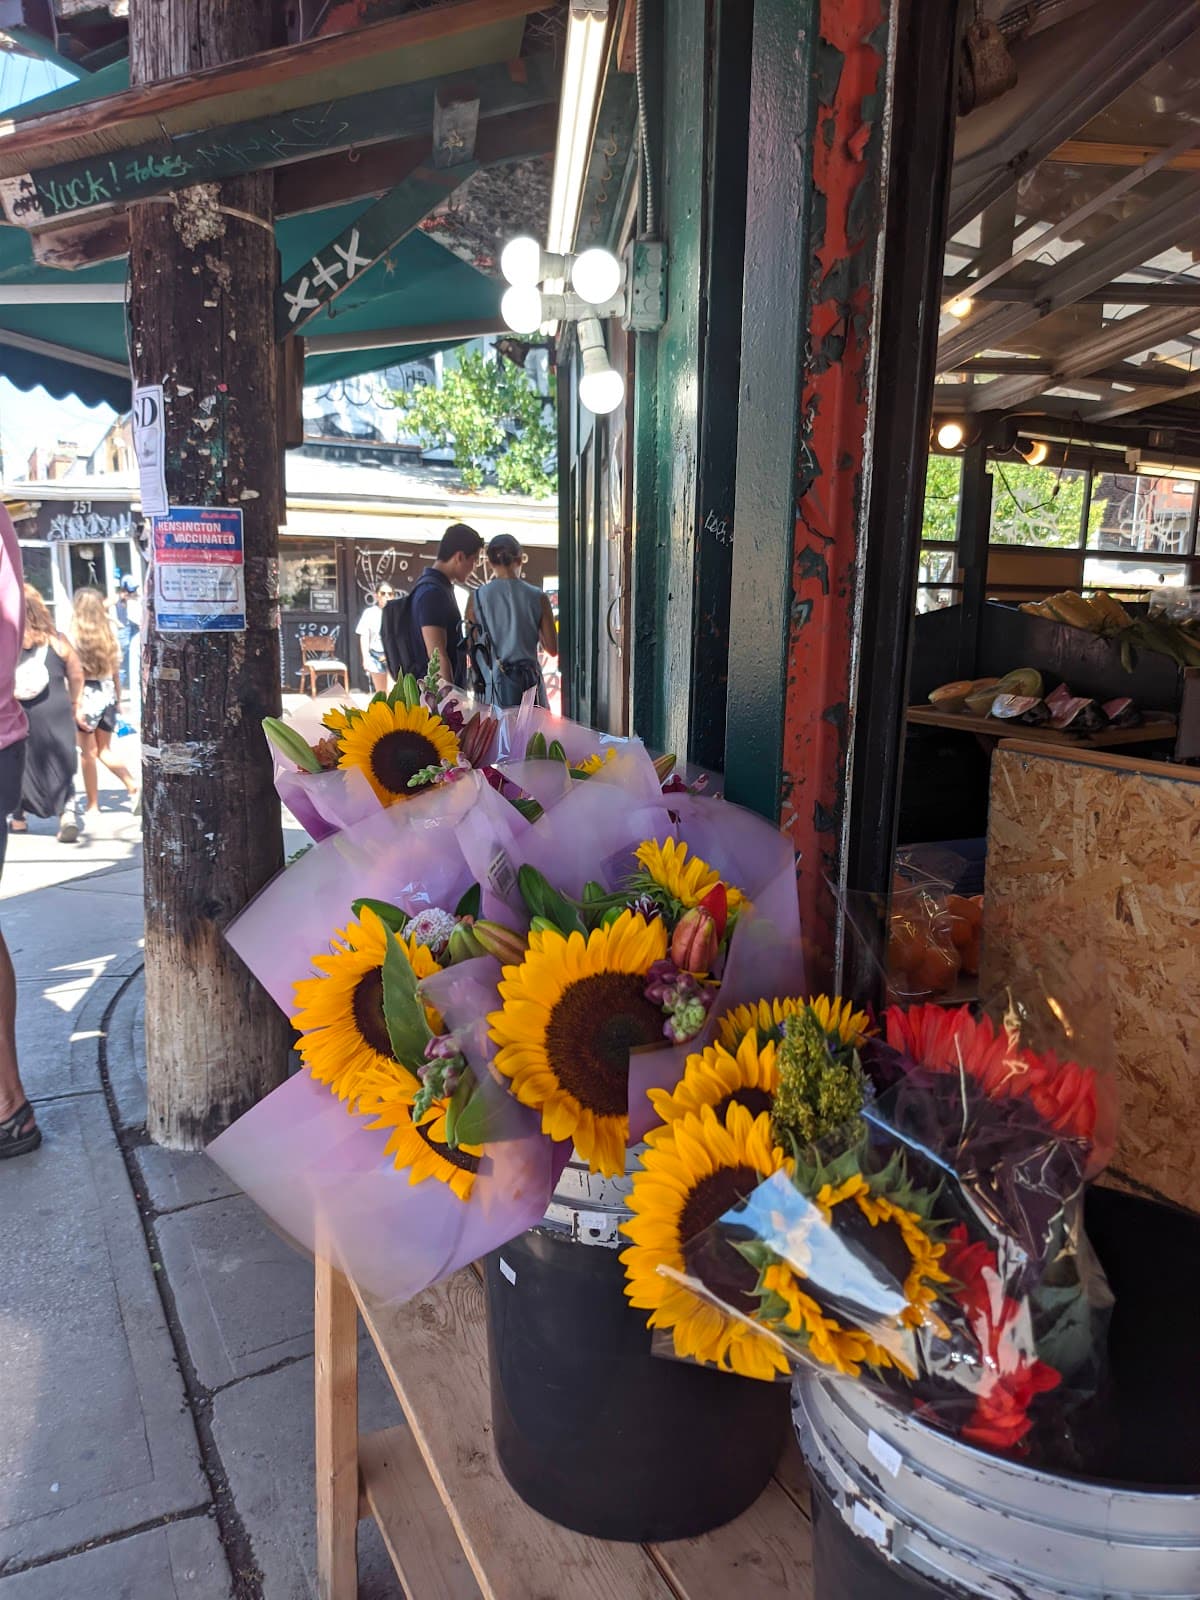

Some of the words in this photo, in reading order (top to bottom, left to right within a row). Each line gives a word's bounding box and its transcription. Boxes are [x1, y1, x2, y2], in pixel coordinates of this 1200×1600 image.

[72, 501, 92, 514] 257
[158, 521, 222, 533] KENSINGTON
[173, 532, 236, 545] VACCINATED
